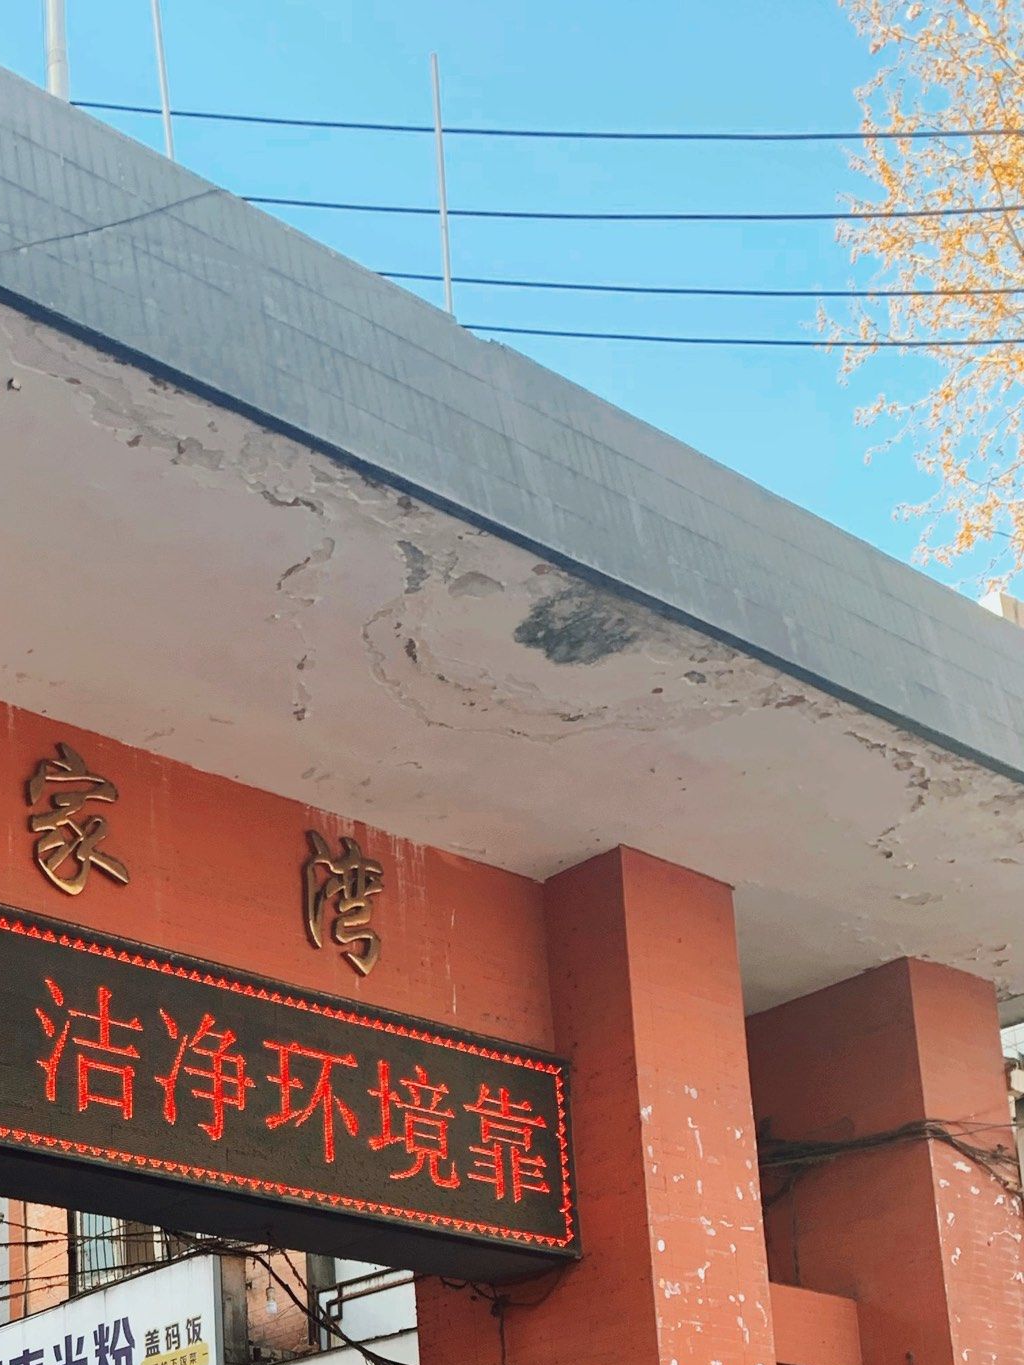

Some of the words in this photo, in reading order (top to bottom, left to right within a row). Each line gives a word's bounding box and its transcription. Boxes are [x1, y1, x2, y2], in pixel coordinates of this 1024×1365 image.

[34, 976, 551, 1204] 洁净环境靠
[145, 1316, 203, 1358] 盖码饭
